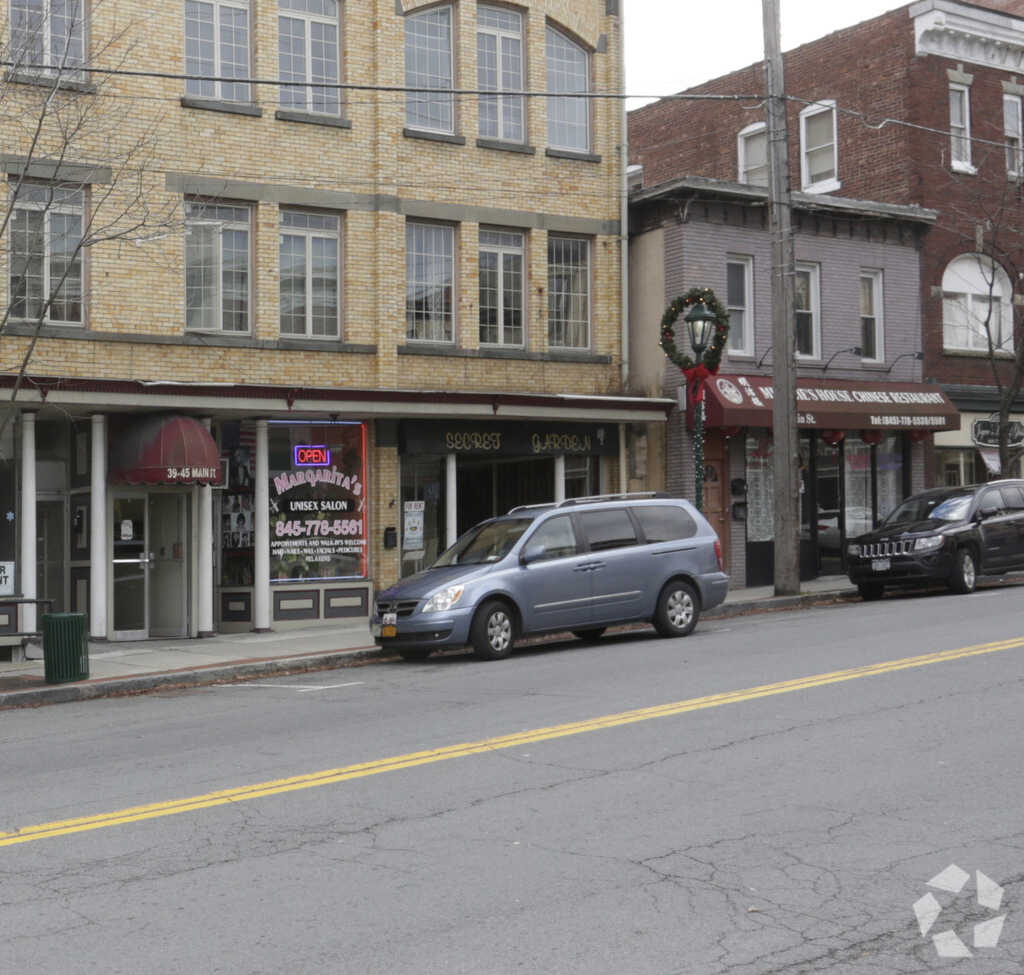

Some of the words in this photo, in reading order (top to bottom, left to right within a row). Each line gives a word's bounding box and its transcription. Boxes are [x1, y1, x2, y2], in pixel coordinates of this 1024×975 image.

[815, 389, 855, 402] HOUSE
[852, 390, 893, 403] CHINESE
[889, 392, 945, 404] RESTAURANT
[446, 432, 501, 450] SECRET
[531, 433, 592, 453] GARDEN
[298, 449, 327, 463] OPEN
[167, 467, 191, 479] 39-45
[191, 467, 209, 478] MAIN
[290, 500, 319, 512] UNISEX
[320, 500, 348, 511] SALON
[275, 519, 363, 537] 845-778-5561
